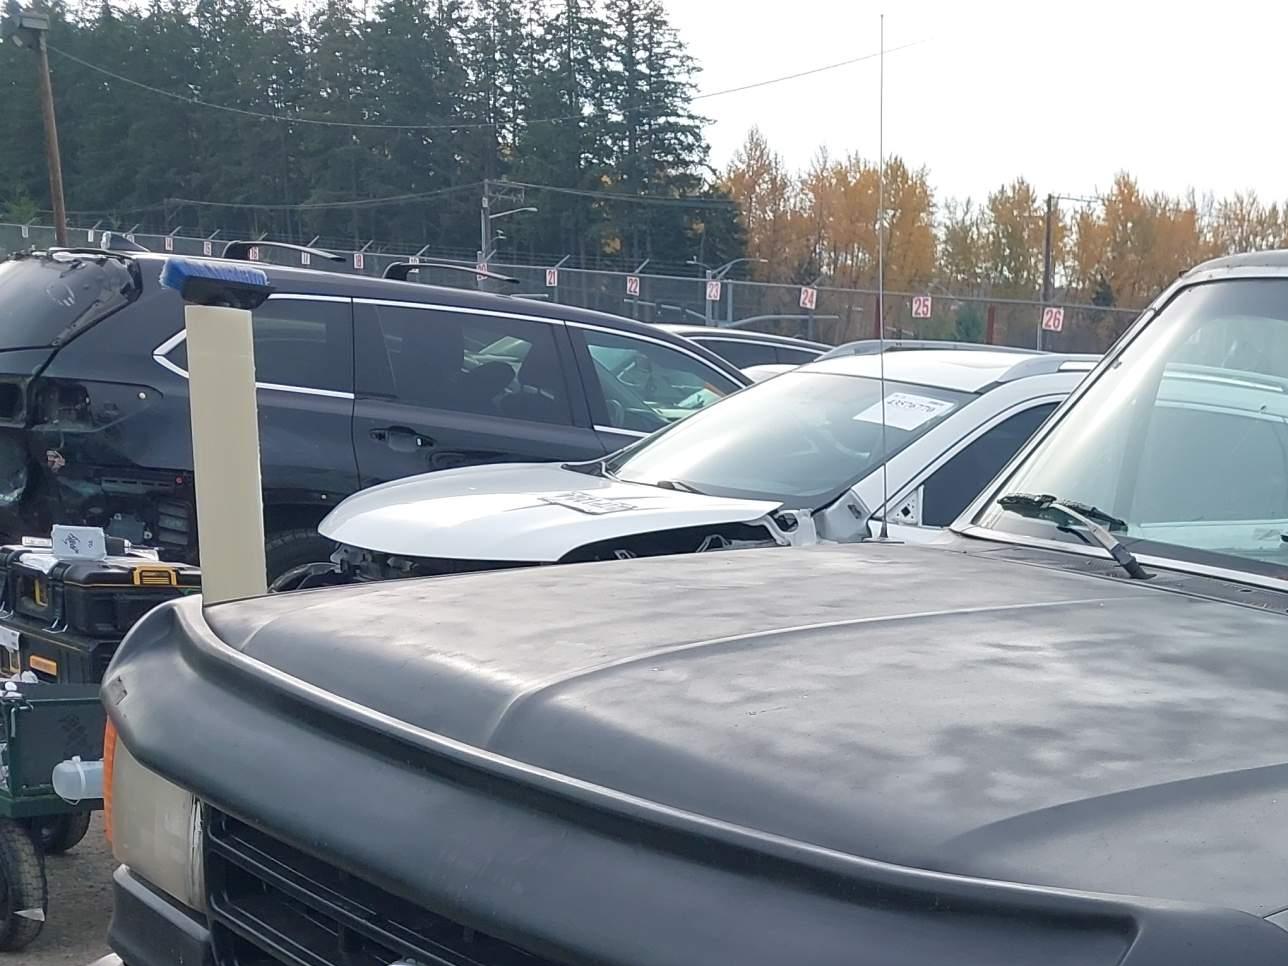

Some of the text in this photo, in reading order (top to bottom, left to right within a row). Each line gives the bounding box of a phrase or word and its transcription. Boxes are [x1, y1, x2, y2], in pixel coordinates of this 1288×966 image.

[802, 289, 815, 307] 24
[914, 299, 930, 317] 25
[1045, 310, 1062, 329] 26
